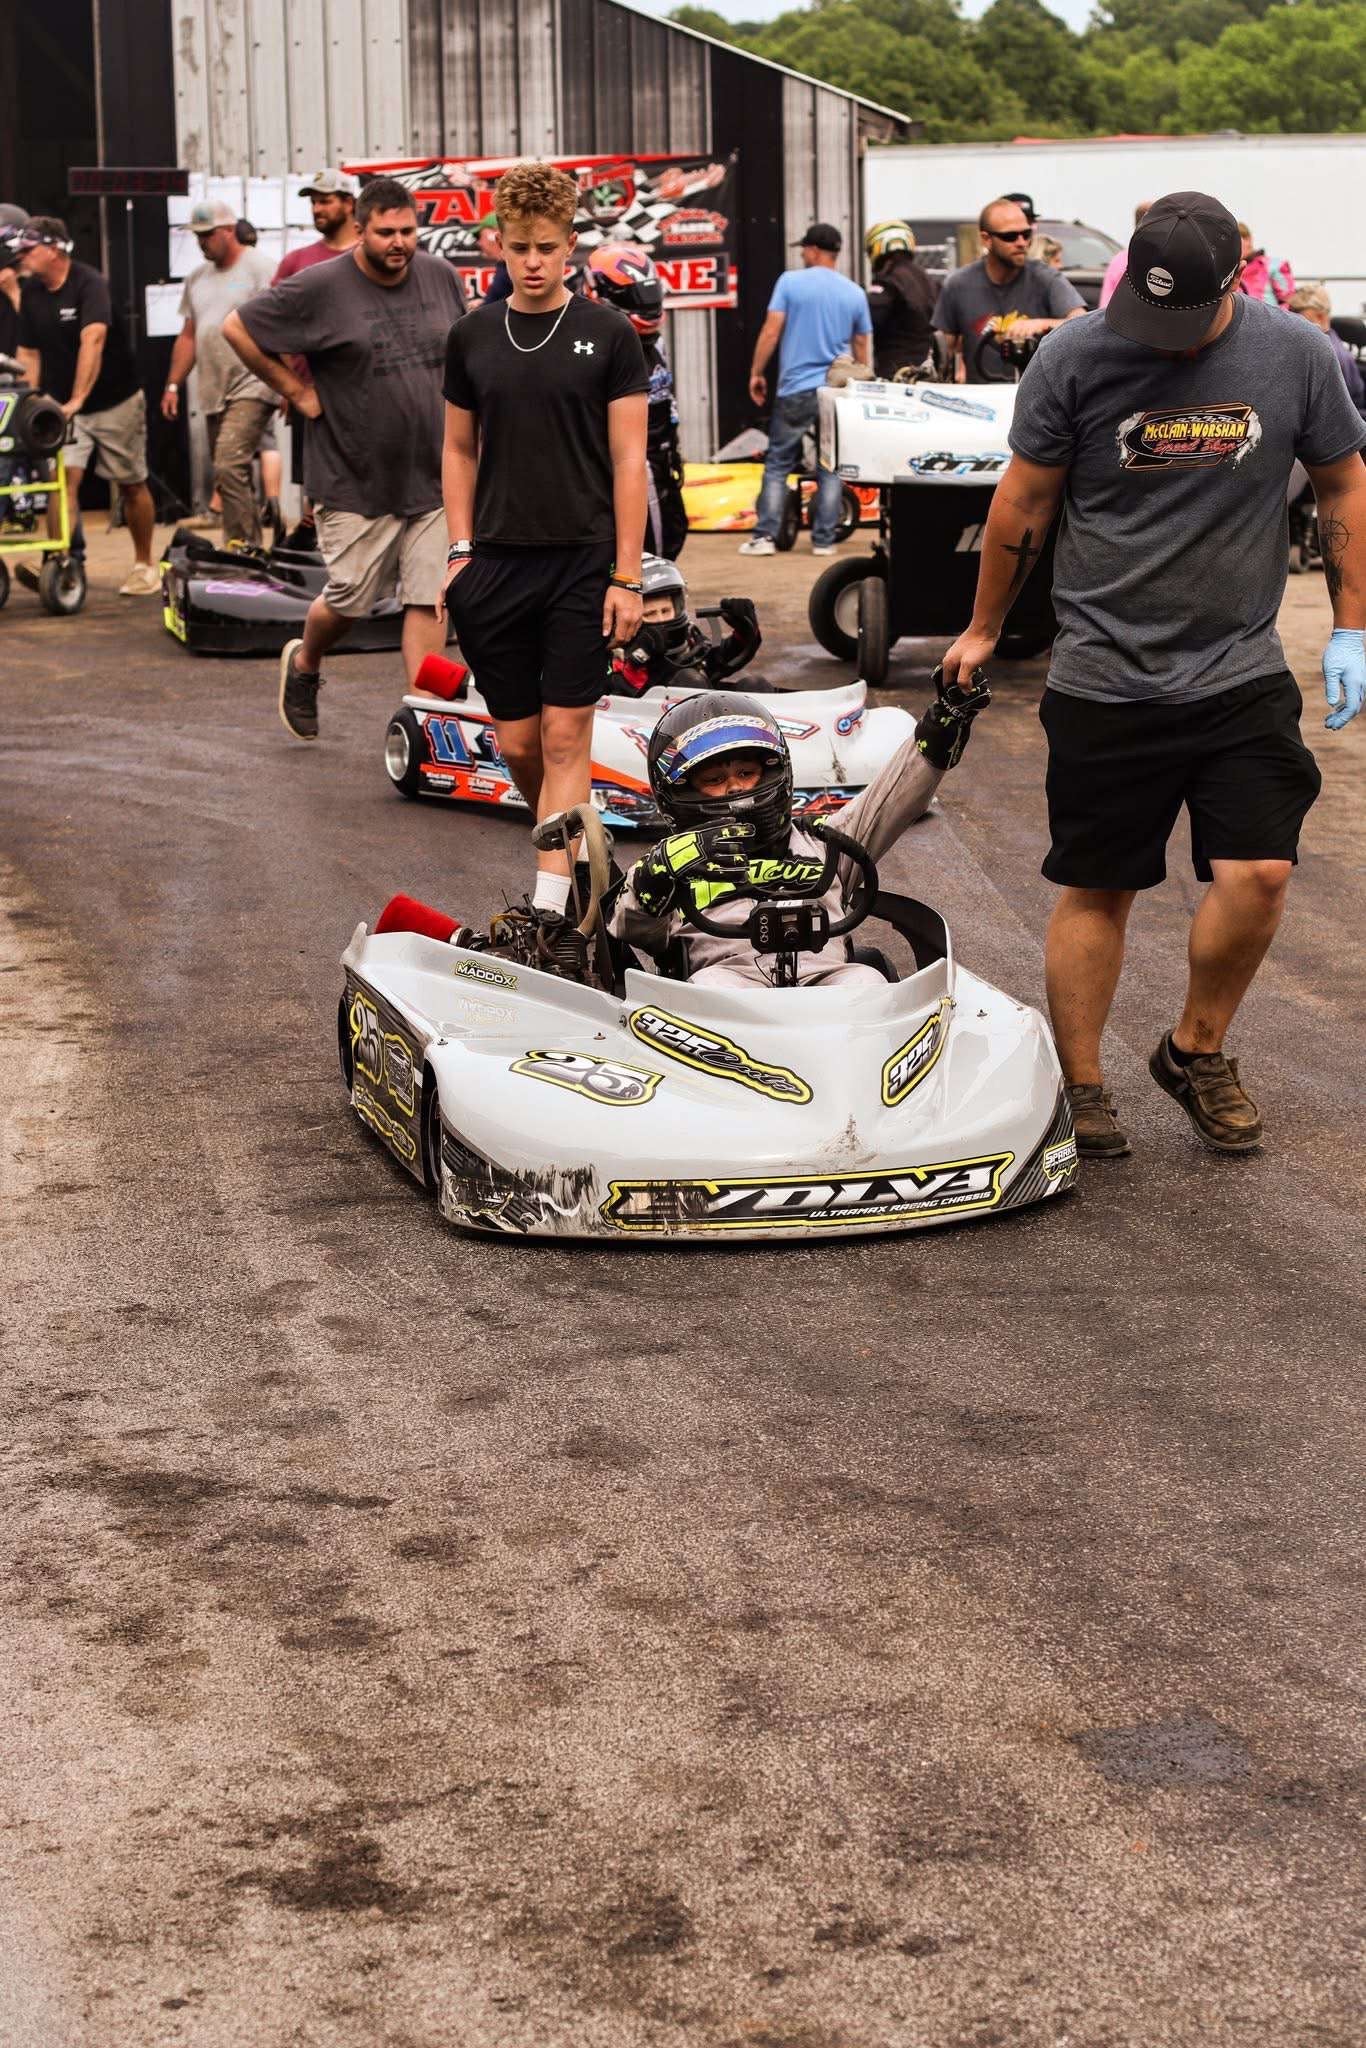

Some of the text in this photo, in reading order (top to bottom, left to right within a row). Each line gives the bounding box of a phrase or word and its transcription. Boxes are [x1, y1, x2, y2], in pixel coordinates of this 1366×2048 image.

[655, 257, 717, 295] NE
[426, 714, 474, 767] 11
[457, 964, 513, 986] MADDOX
[637, 1012, 730, 1056] 325
[520, 1051, 657, 1102] 25
[888, 1027, 936, 1098] 325
[809, 1190, 993, 1219] ULTRAMAX RACING CHASSIS
